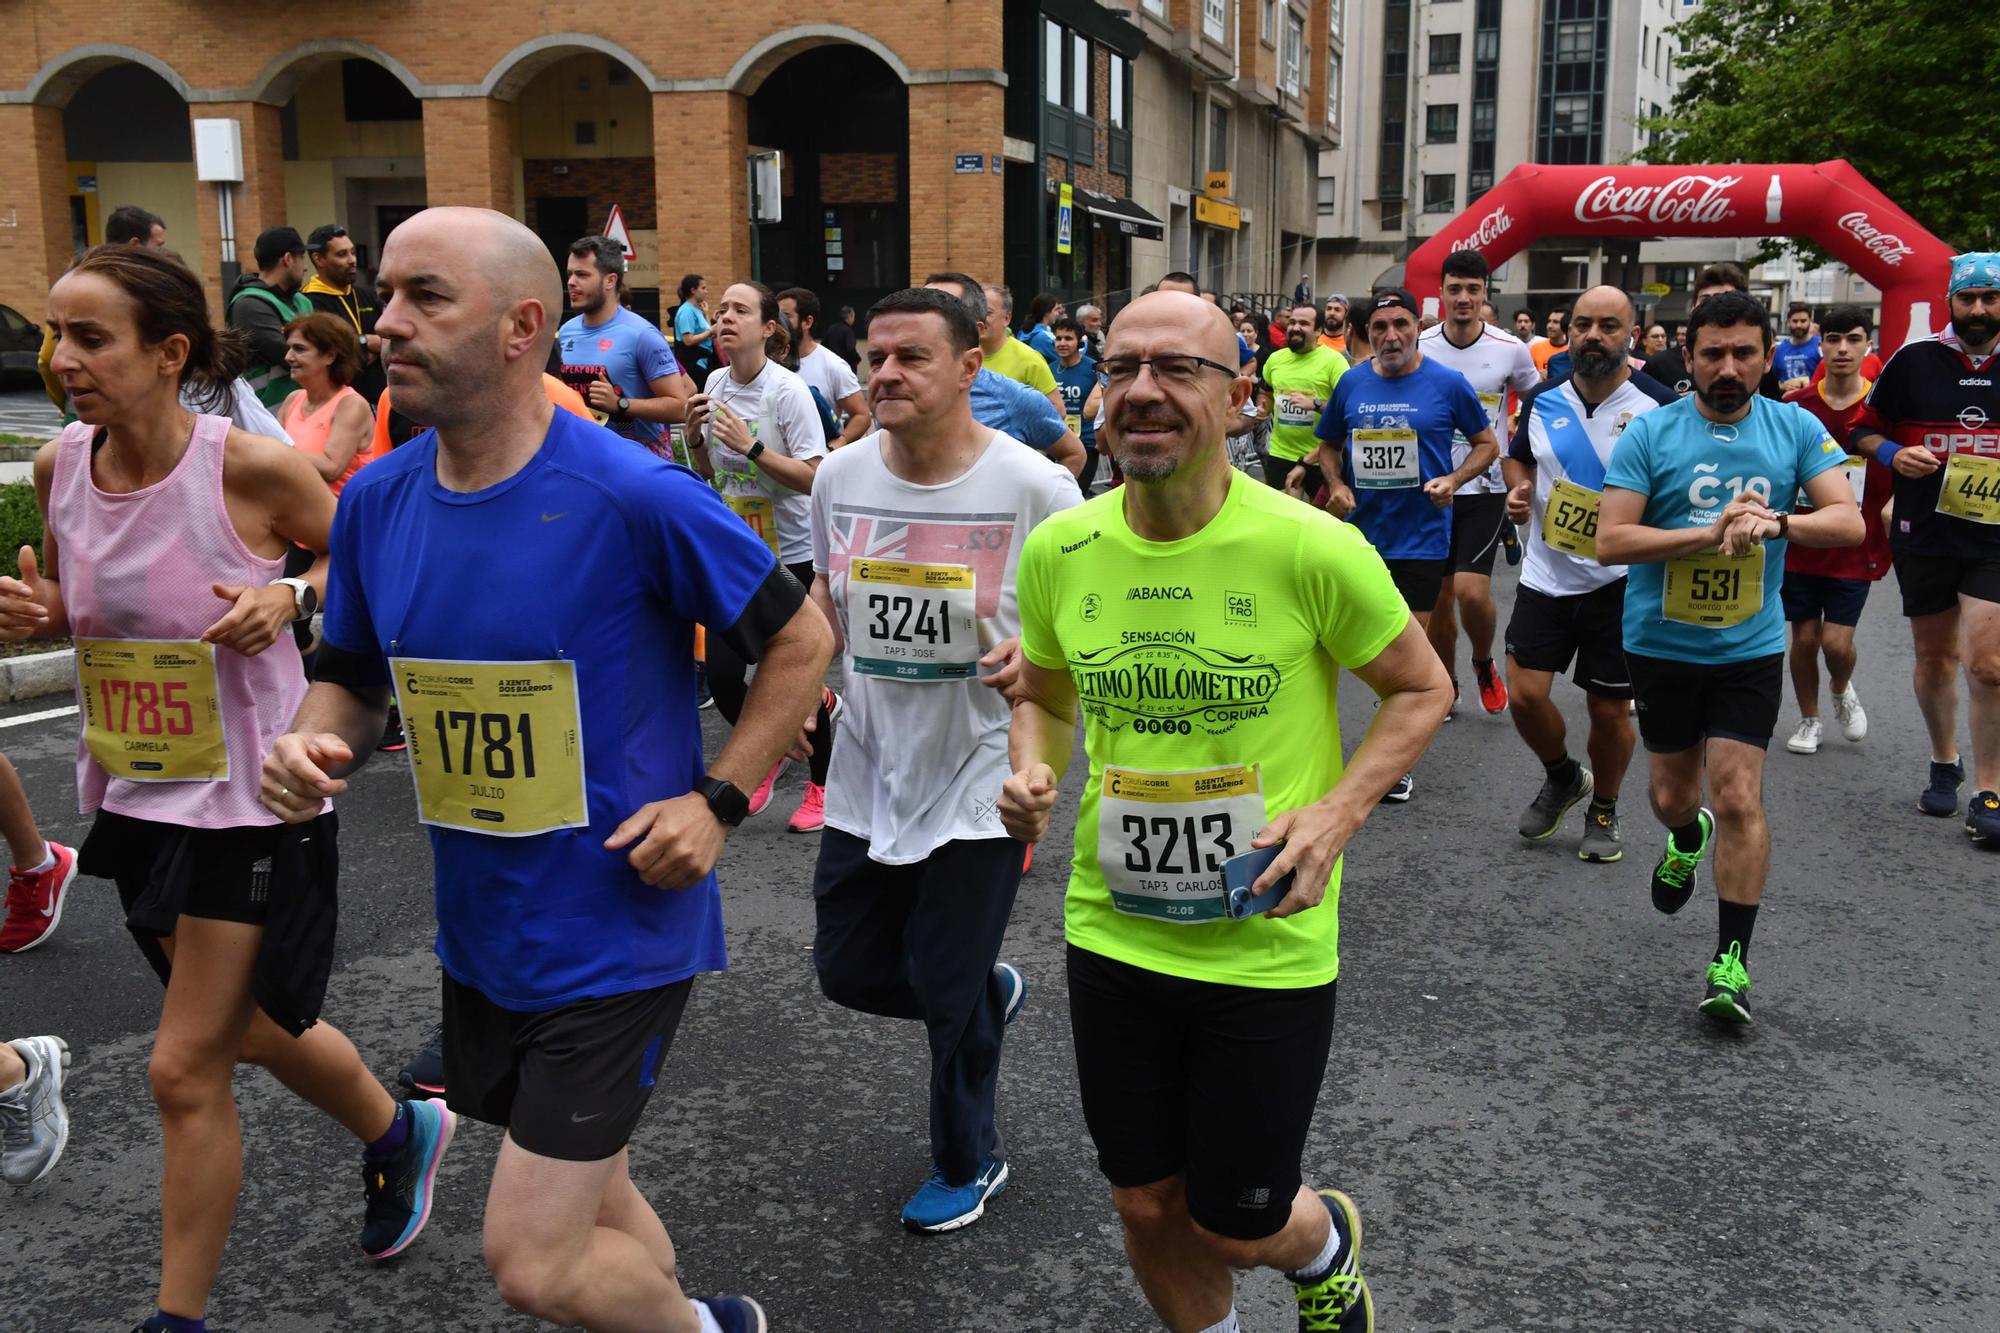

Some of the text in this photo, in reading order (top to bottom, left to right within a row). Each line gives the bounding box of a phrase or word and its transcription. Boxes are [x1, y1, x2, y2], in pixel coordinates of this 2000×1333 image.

[1209, 180, 1226, 189] 404
[1574, 175, 1744, 223] Coca-Cola
[1838, 212, 1915, 266] Coca-Cola
[1958, 378, 1992, 386] adidas
[1924, 433, 2000, 453] OPE
[1363, 446, 1406, 469] 3312
[1060, 533, 1092, 554] luanvi
[1691, 568, 1740, 601] 531
[1228, 596, 1252, 607] CAS
[869, 594, 951, 644] 3241
[1228, 606, 1252, 617] TRO
[1120, 629, 1196, 645] SENSACIÓN
[883, 645, 936, 658] TAP3 JOSE
[896, 666, 919, 675] 22.05
[516, 684, 552, 693] BARRIOS
[1133, 662, 1271, 702] KILÓMETRO
[100, 679, 194, 735] 1785
[1203, 704, 1269, 723] CORUÑA
[1136, 720, 1190, 734] 2020
[124, 740, 170, 752] CARMELA
[434, 710, 535, 779] 1781
[1195, 784, 1210, 792] DOS
[1212, 779, 1244, 790] BARRIOS
[1202, 776, 1225, 785] XENTE
[470, 784, 505, 800] JULIO
[1122, 812, 1235, 874] 3213
[1139, 879, 1222, 892] TAP3 CARLOS
[1166, 905, 1195, 915] 22.05
